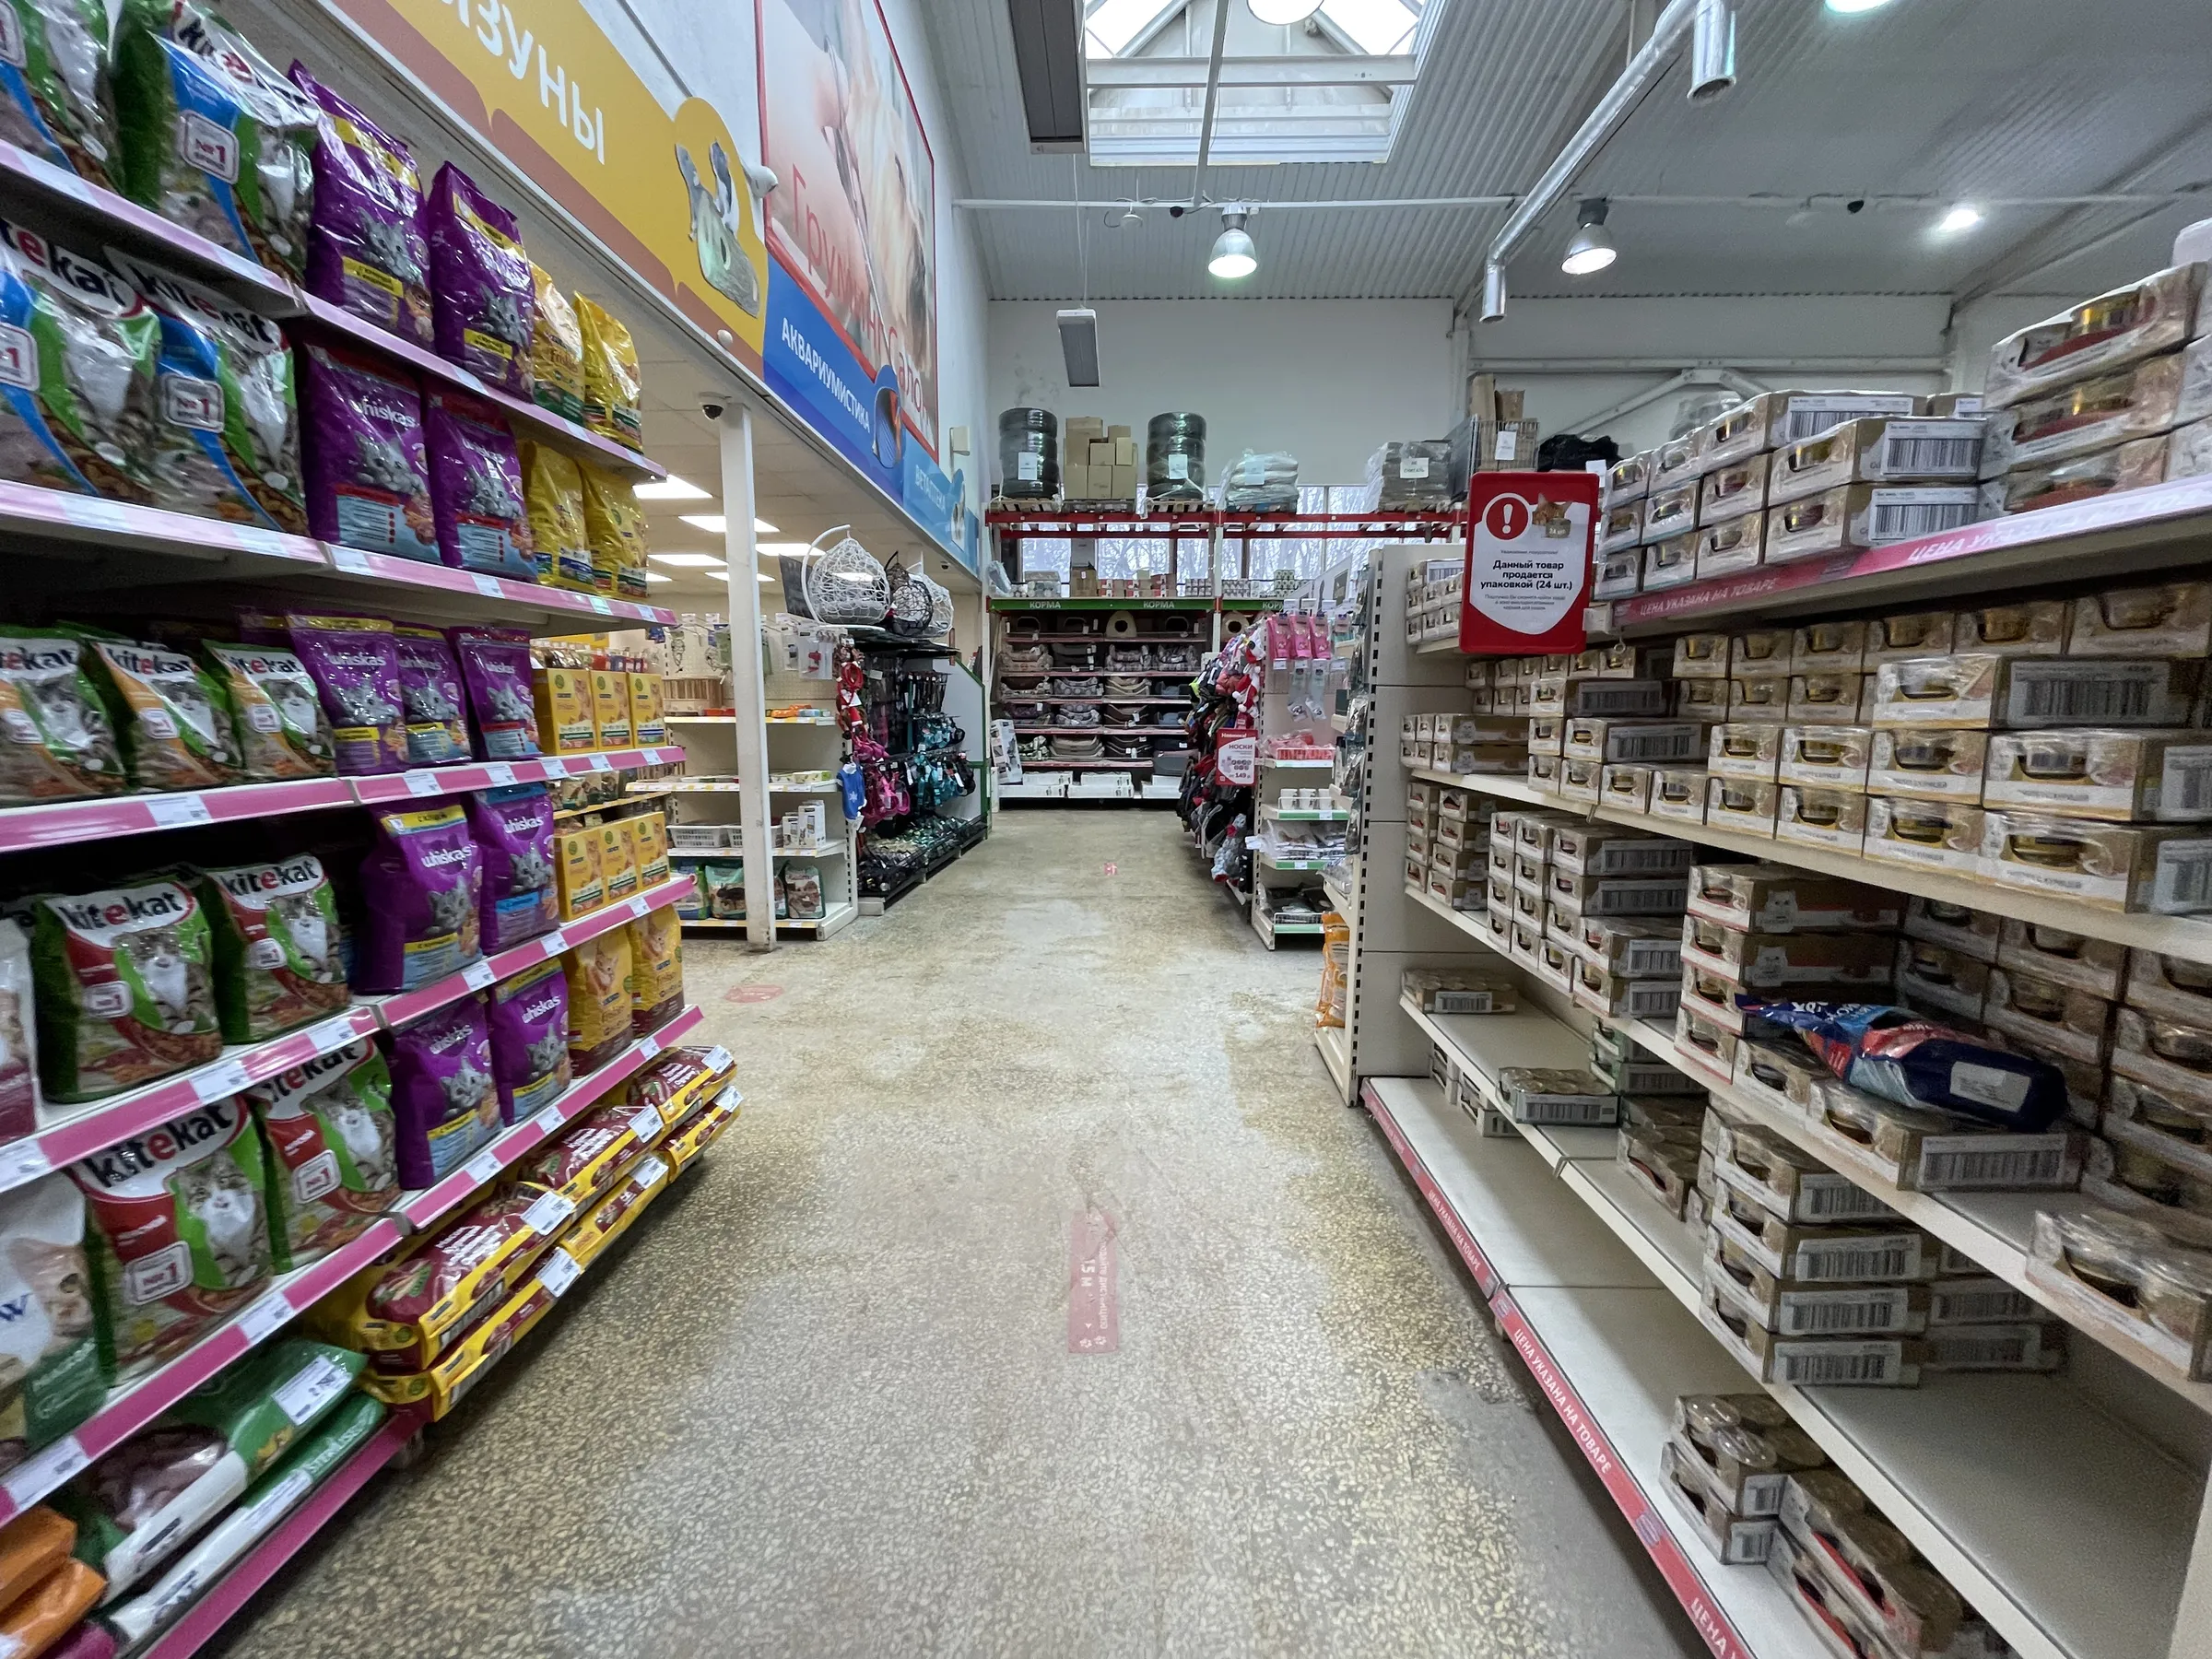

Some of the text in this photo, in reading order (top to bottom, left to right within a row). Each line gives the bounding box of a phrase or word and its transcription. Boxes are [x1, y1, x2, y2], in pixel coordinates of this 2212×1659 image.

[781, 317, 870, 434] АКВАРИУМИСТИКА
[1907, 538, 1966, 561] ЦЕНА
[1492, 559, 1564, 571] Данный товар
[1502, 571, 1553, 580] продается
[1480, 579, 1572, 591] упаковкой (24 шт.)
[1640, 577, 1778, 616] ЦЕНА УКАЗАНА НА ТОВАРЕ
[1030, 600, 1061, 609] КОРМА
[1143, 600, 1175, 609] КОРМА
[503, 816, 545, 834] whiskas
[421, 844, 474, 868] whiskas
[221, 858, 318, 896] kitekat
[58, 891, 183, 930] kitekat
[521, 994, 561, 1024] whiskas
[1428, 1190, 1481, 1272] ЦЕНА УКАЗАНА НА ТОВАРЕ
[1513, 1327, 1611, 1475] ЦЕНА УКАЗАНА НА ТОВАРЕ
[1690, 1597, 1729, 1653] ЦЕНА
